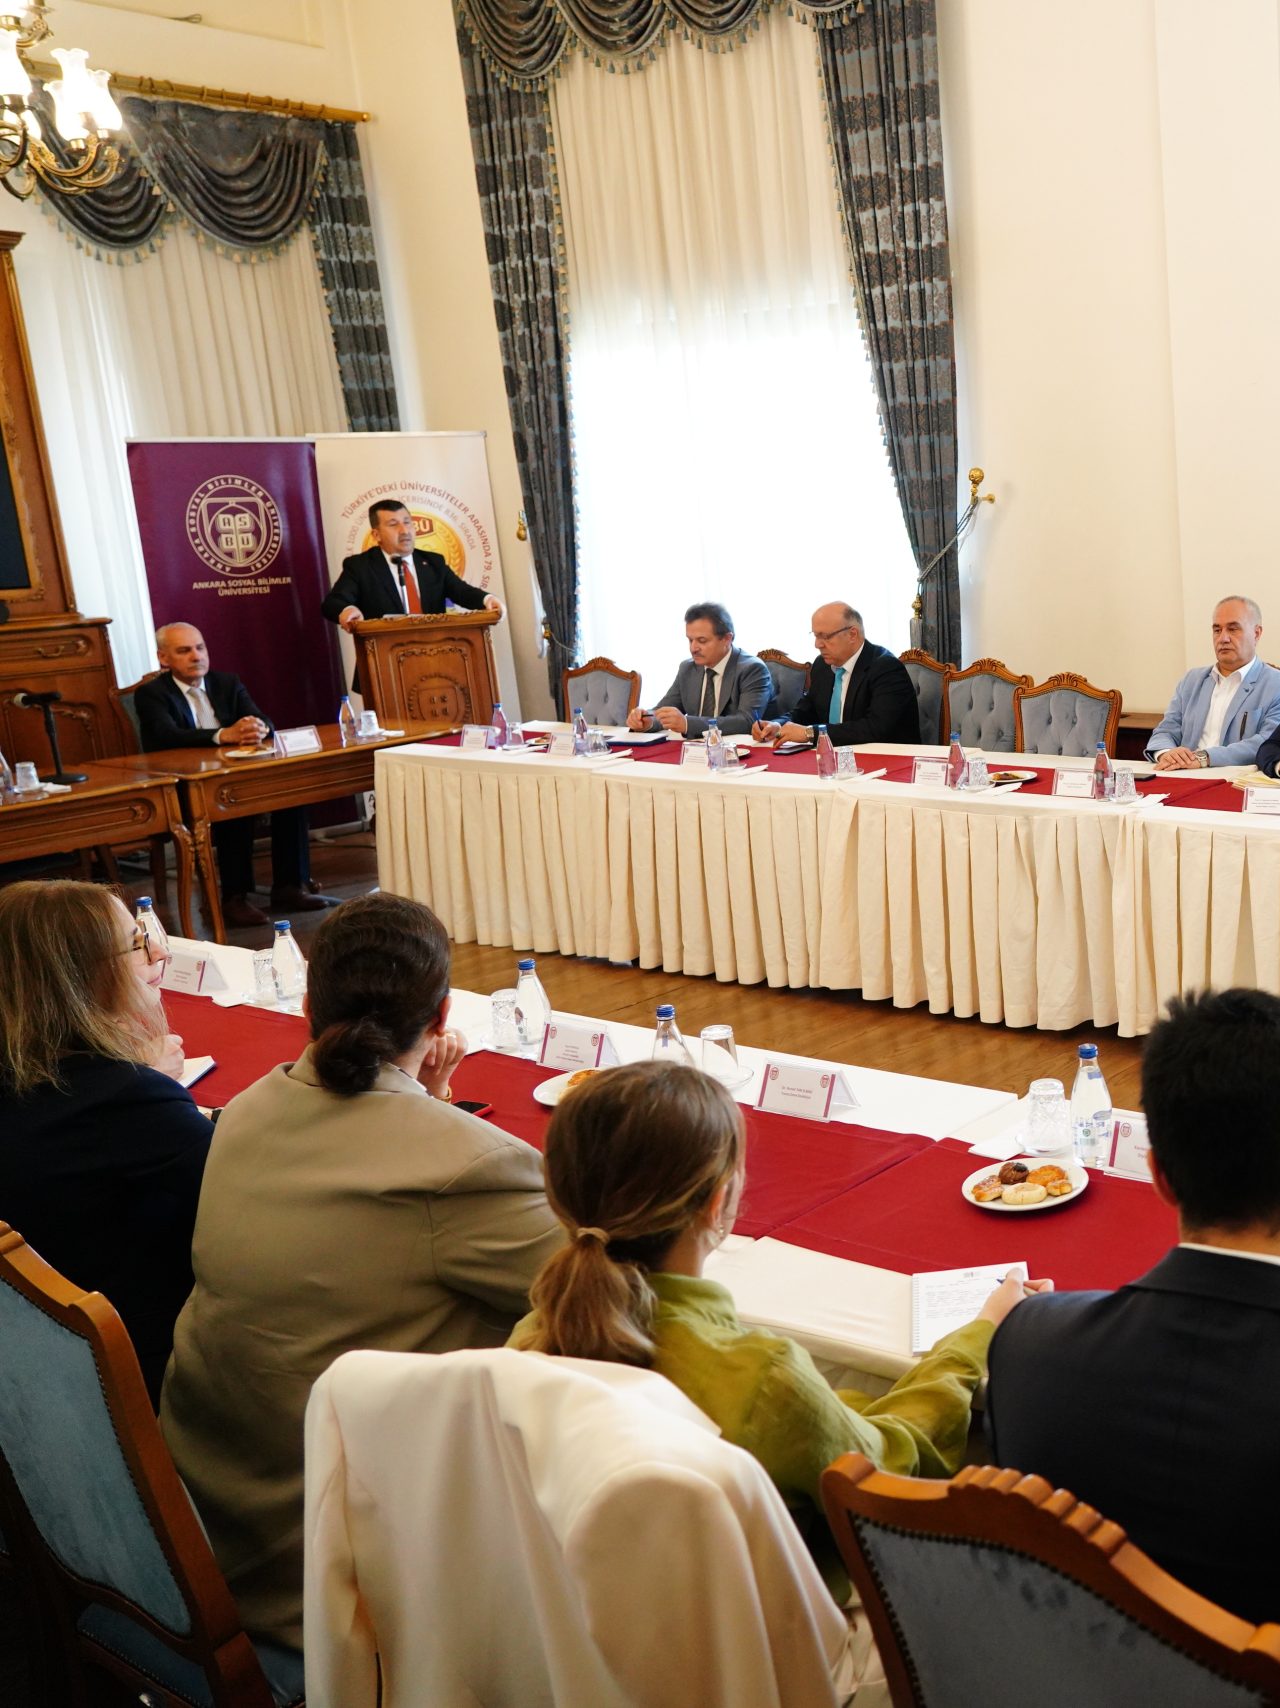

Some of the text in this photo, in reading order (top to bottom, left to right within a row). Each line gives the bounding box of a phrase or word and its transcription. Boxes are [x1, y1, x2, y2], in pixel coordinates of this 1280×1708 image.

[400, 480, 469, 515] ÜNİVERSİTELER
[468, 514, 493, 558] ARASINDA
[193, 576, 292, 589] ANKARA SOSYAL BİLİMLER
